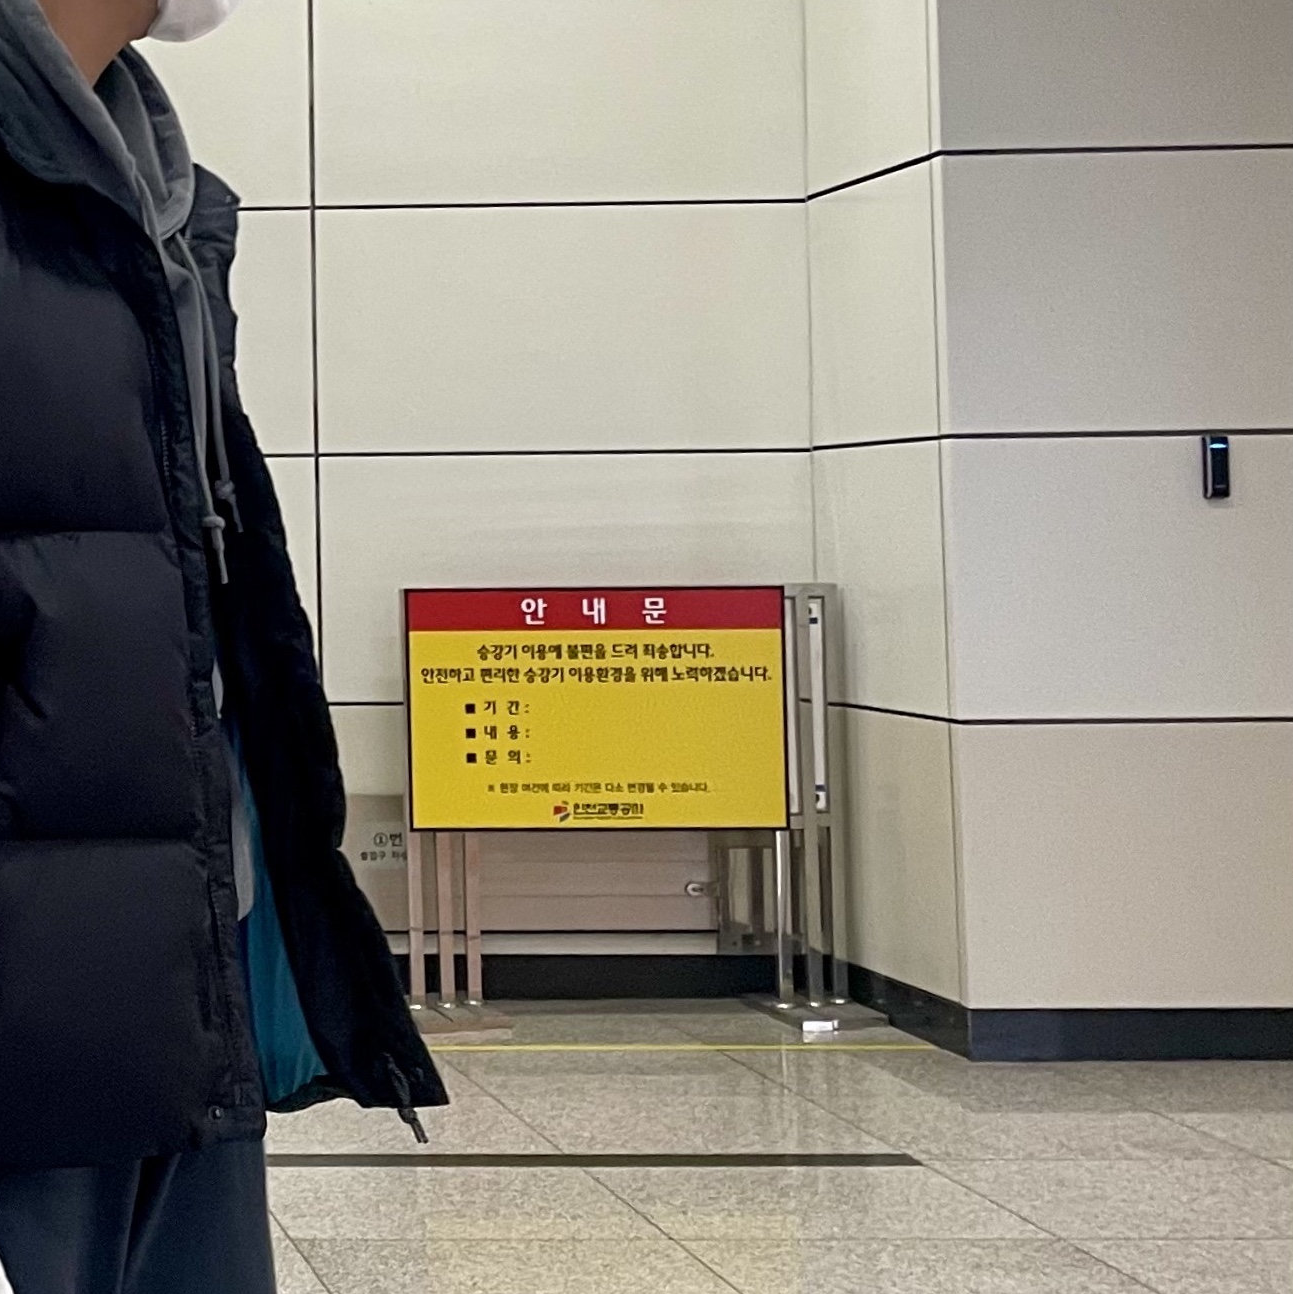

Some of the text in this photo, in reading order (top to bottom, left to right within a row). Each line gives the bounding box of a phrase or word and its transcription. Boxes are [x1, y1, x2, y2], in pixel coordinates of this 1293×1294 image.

[477, 643, 715, 661] 승강기 이용에 불편을 드려 죄송합니다.
[421, 666, 772, 684] 안전하고 편리한 승강기 이용환경을 위해 노력하겠습니다.
[658, 783, 667, 792] 수
